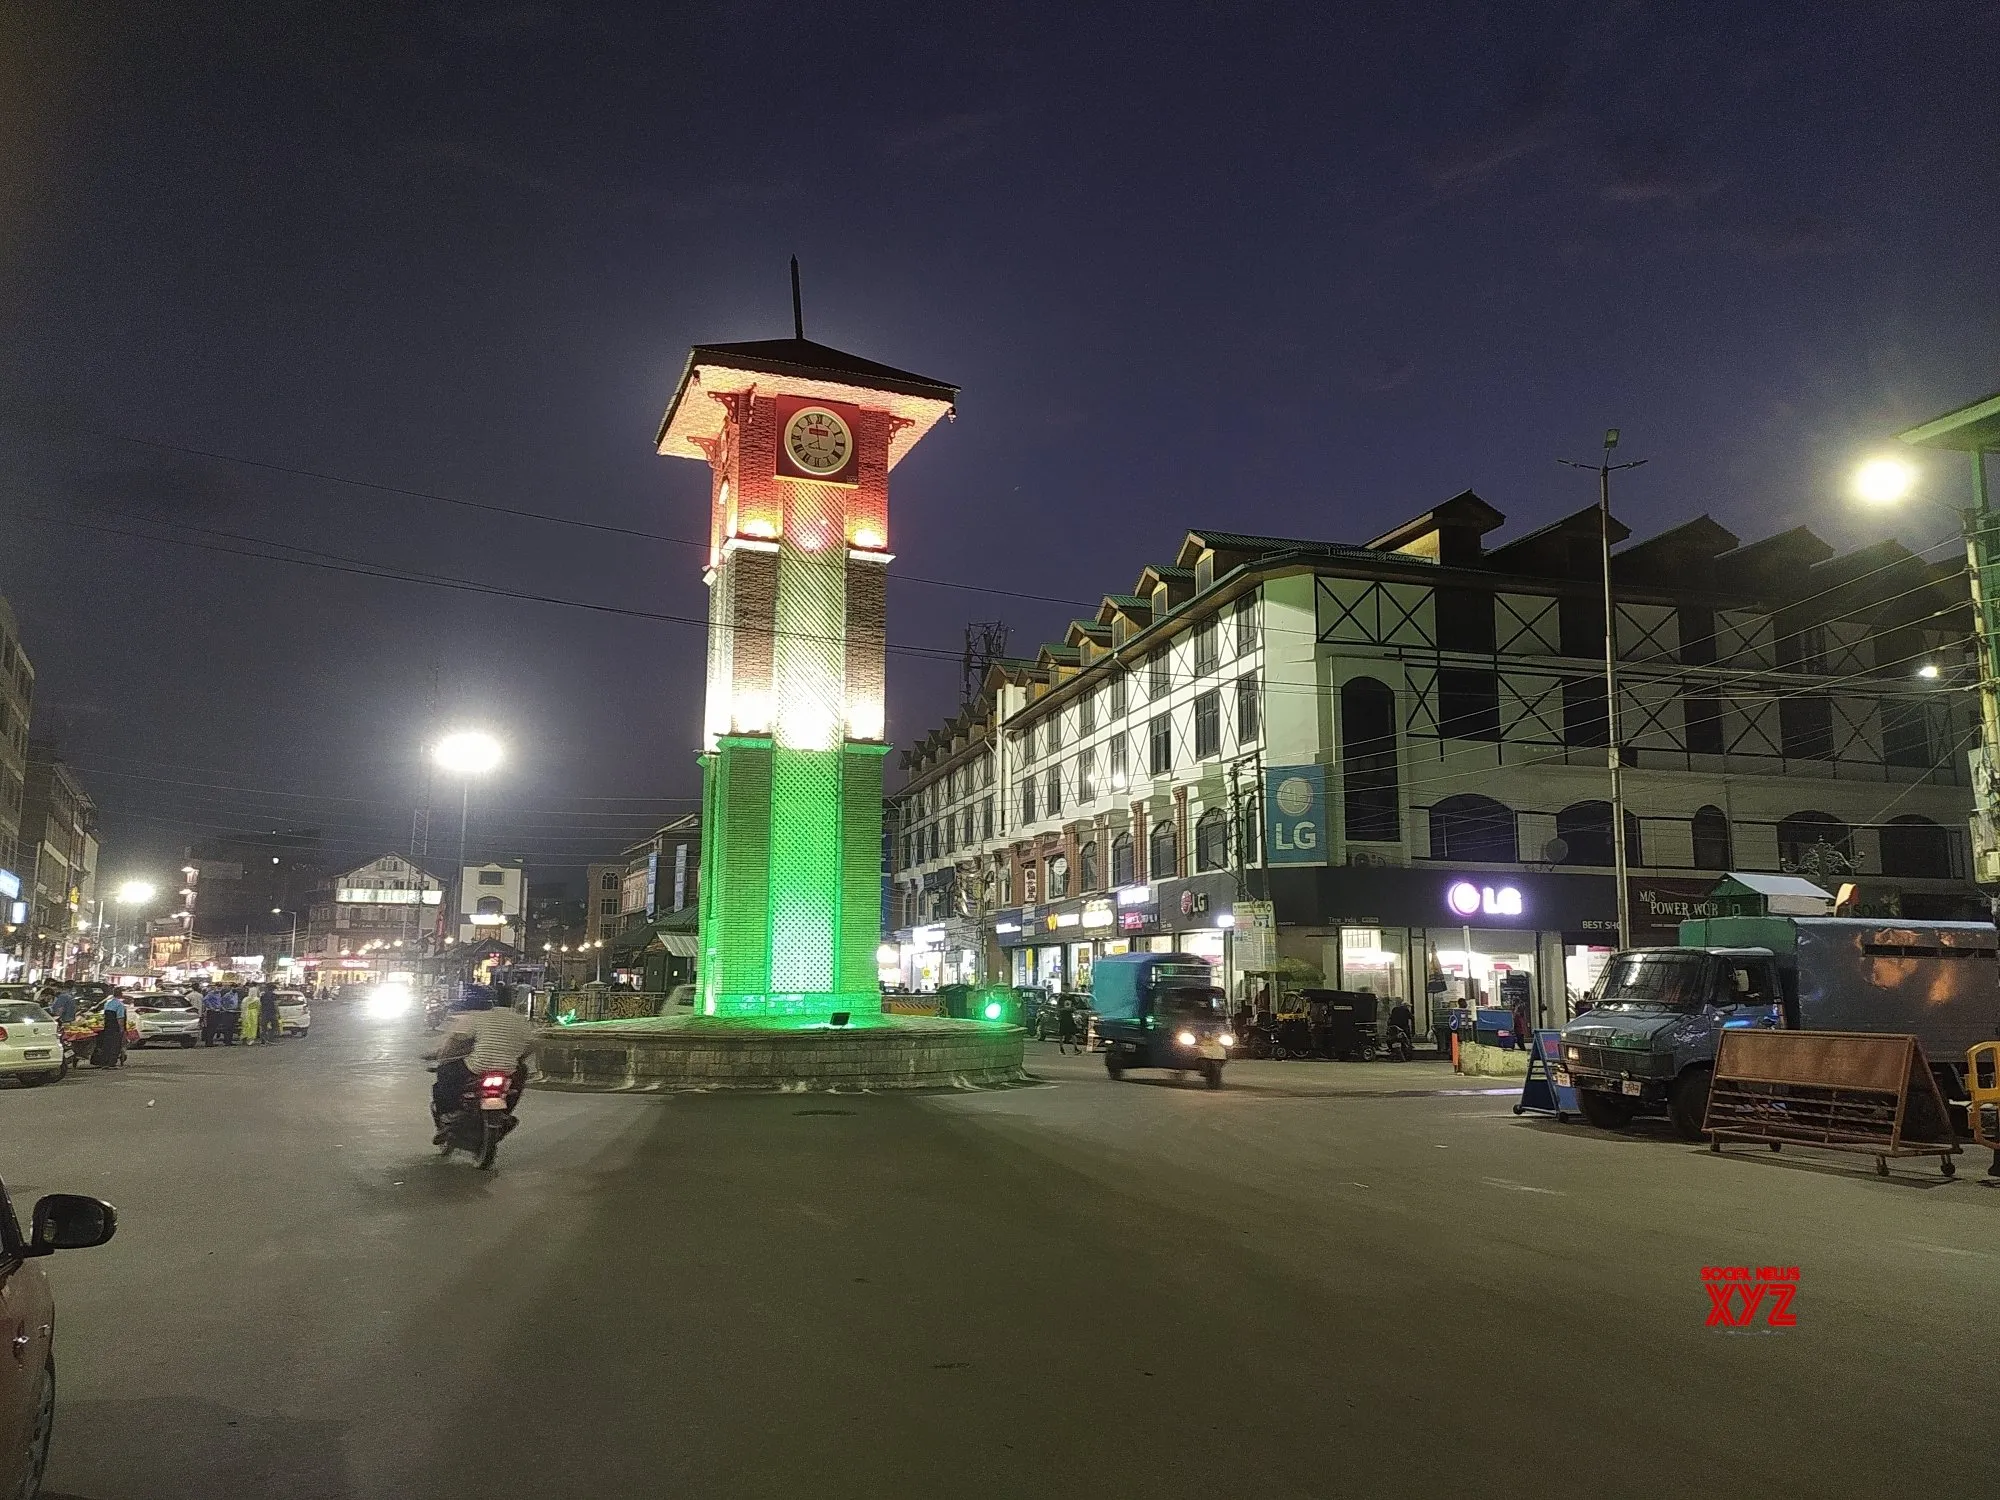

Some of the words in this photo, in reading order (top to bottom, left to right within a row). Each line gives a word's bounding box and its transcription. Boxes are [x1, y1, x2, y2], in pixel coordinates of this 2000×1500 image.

[1275, 821, 1316, 850] LG
[1192, 892, 1208, 913] LG
[1483, 887, 1522, 915] LG
[1650, 902, 1690, 916] POWER
[1582, 920, 1603, 929] BEST
